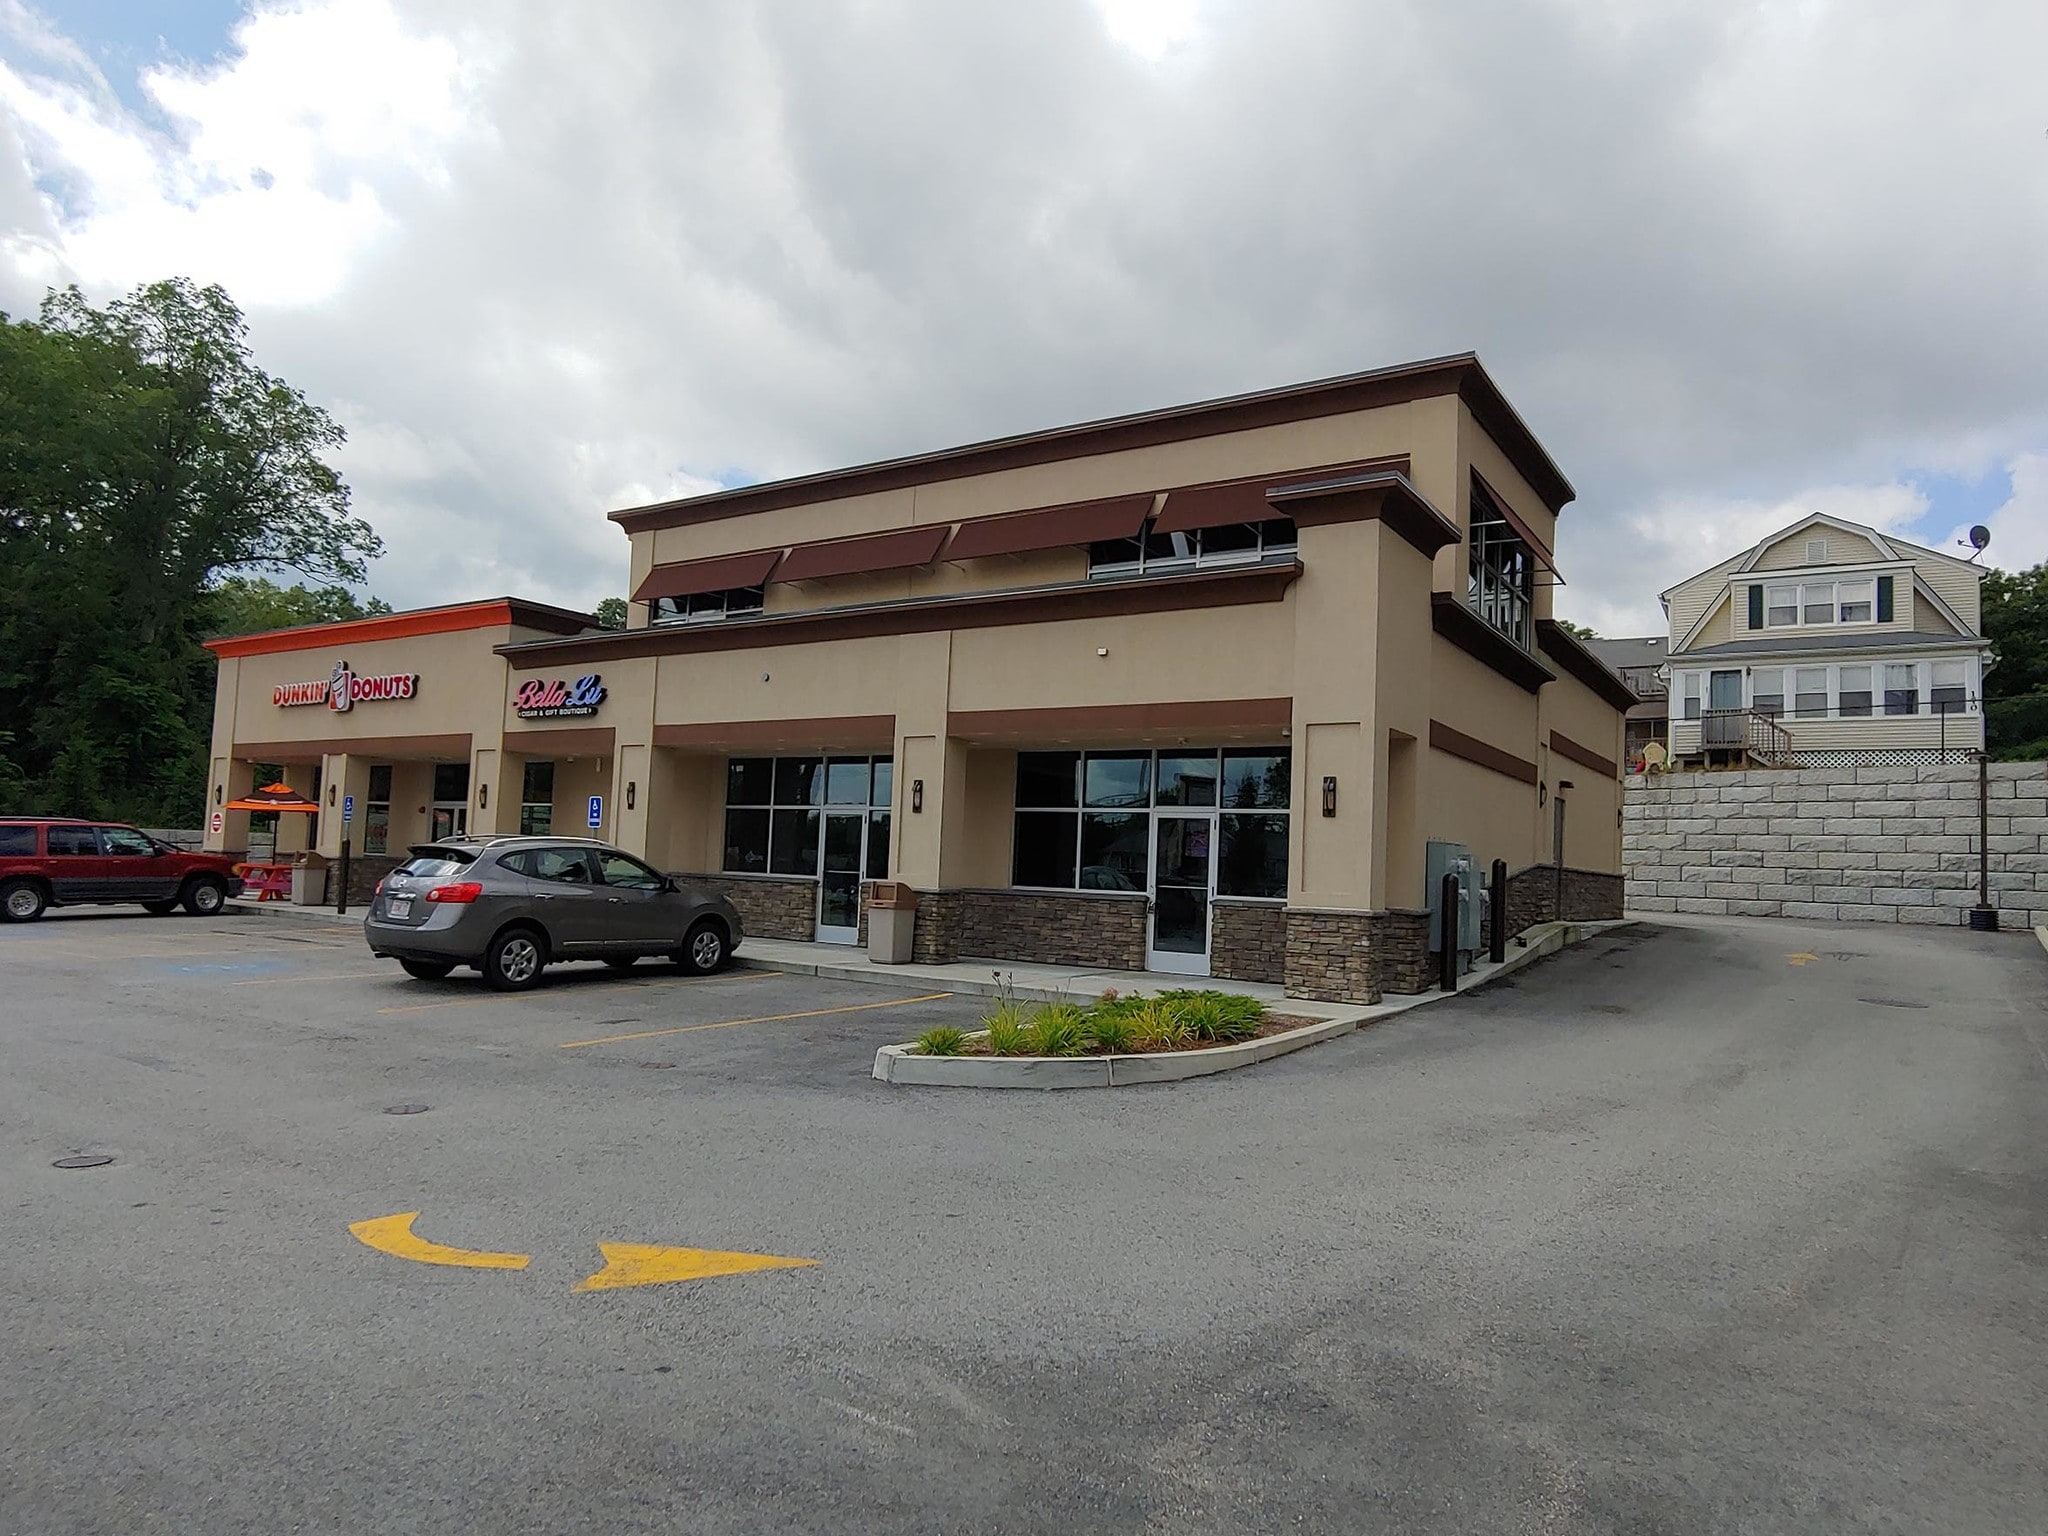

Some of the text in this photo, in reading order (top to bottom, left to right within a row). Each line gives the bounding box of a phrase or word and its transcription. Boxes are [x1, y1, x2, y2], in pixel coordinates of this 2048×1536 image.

[273, 674, 412, 706] DUNKIN' DONUTS
[513, 675, 602, 709] Bella Lu
[545, 708, 558, 716] GIFT
[559, 707, 588, 716] BOUTIQUE
